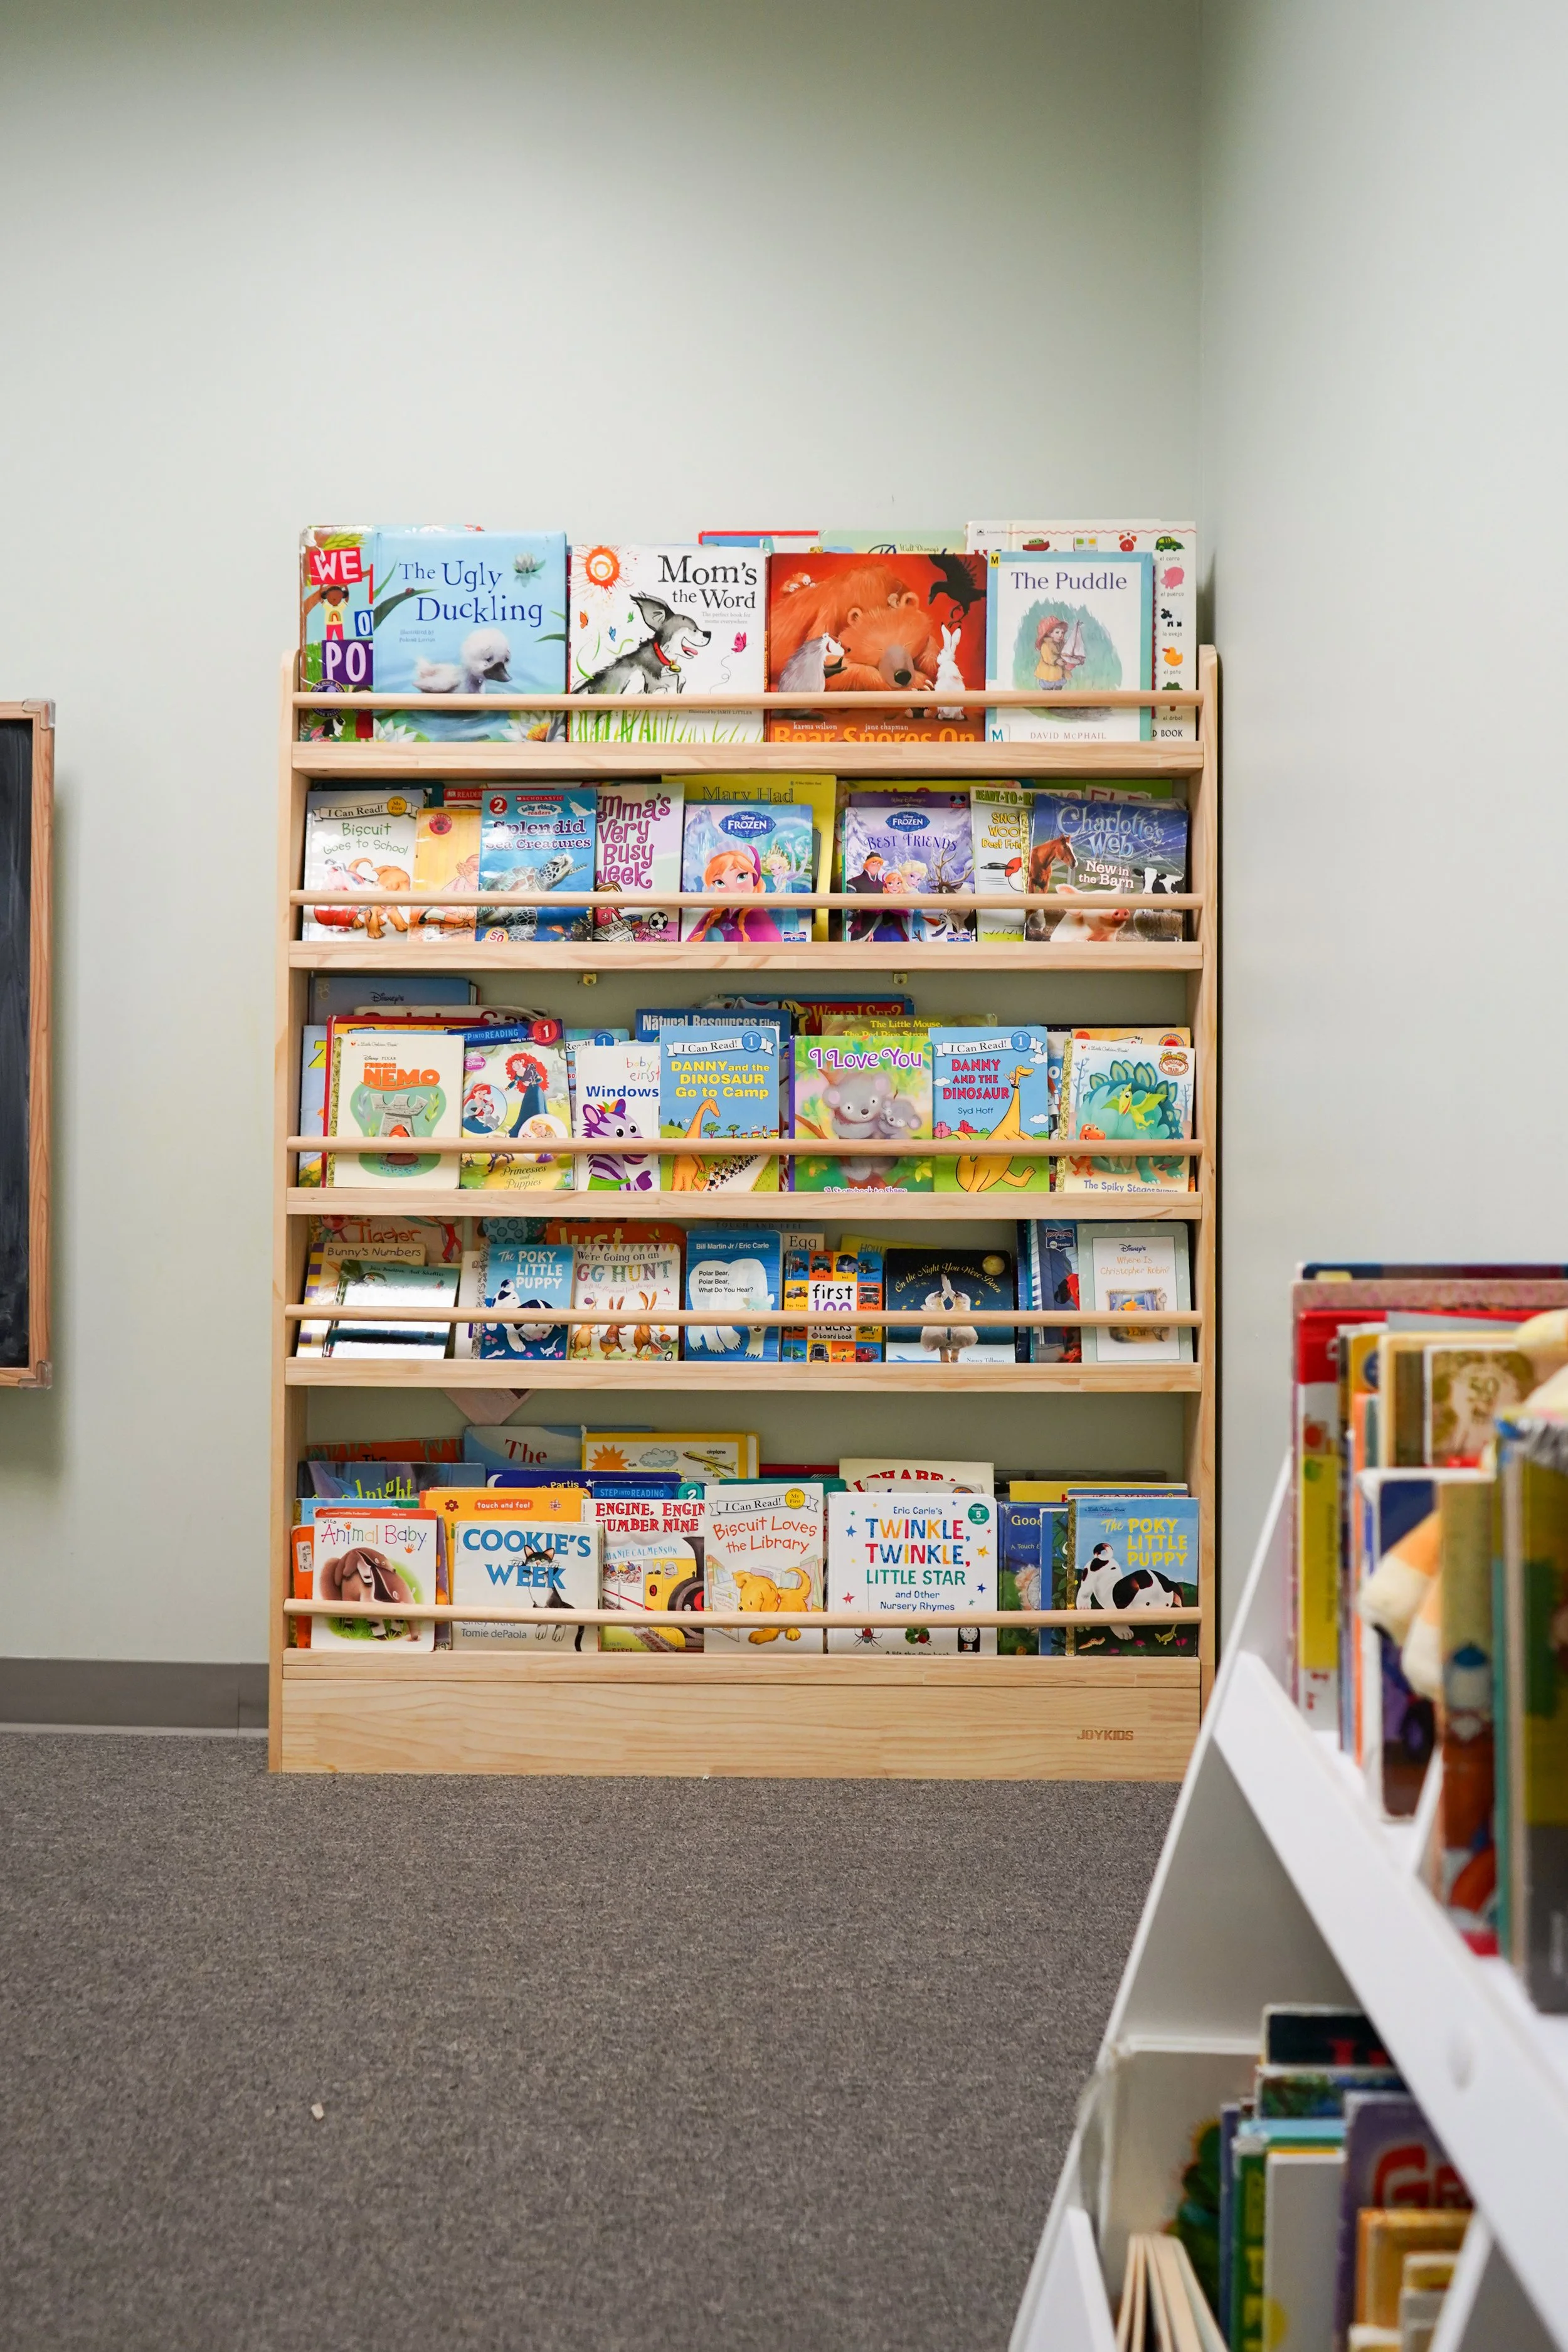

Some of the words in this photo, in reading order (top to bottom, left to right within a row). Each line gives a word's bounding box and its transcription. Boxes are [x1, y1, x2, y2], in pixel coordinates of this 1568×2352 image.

[314, 550, 359, 580] WE
[991, 556, 998, 564] M
[658, 555, 757, 585] Mom's
[399, 563, 435, 580] The
[442, 560, 502, 593] Ugly
[1011, 572, 1049, 590] The
[1056, 571, 1128, 590] Puddle
[672, 590, 697, 603] the
[699, 589, 756, 608] Word
[416, 595, 543, 627] Duckling
[865, 723, 878, 733] jane
[881, 724, 909, 732] chapman
[1161, 729, 1184, 738] BOOK
[758, 788, 793, 803] Had
[334, 809, 353, 817] Can
[357, 805, 384, 816] Read!
[494, 800, 503, 812] 2
[342, 823, 391, 837] Biscuit
[493, 819, 586, 837] Splendid
[728, 820, 766, 830] FROZEN
[1057, 806, 1165, 843] Charlotte's
[324, 841, 351, 855] Goes
[357, 839, 368, 848] to
[374, 840, 408, 856] School
[516, 839, 591, 849] Creatures
[982, 838, 1002, 849] Best
[1088, 832, 1134, 858] Web
[1086, 860, 1118, 875] New
[1119, 866, 1130, 877] in
[1079, 874, 1098, 884] the
[1099, 875, 1135, 889] Barn
[871, 1020, 886, 1028] The
[889, 1020, 911, 1028] Little
[913, 1020, 943, 1029] Mouse,
[485, 1029, 519, 1039] READING
[543, 1025, 549, 1038] 1
[681, 1044, 685, 1052] I
[688, 1044, 707, 1052] Can
[712, 1040, 737, 1050] Read!
[748, 1037, 754, 1046] 1
[951, 1044, 954, 1052] I
[957, 1044, 977, 1053] Can
[980, 1040, 1007, 1050] Read!
[1018, 1037, 1024, 1046] 1
[627, 1057, 653, 1072] baby
[810, 1049, 822, 1069] I
[827, 1048, 879, 1069] Love
[882, 1048, 923, 1068] You
[671, 1061, 728, 1072] DANNY
[728, 1064, 748, 1072] and
[751, 1064, 770, 1072] the
[952, 1059, 1001, 1071] DANNY
[363, 1069, 440, 1086] NEMO
[680, 1074, 765, 1084] DINOSAUR
[953, 1075, 977, 1084] AND
[978, 1075, 998, 1083] THE
[586, 1086, 659, 1097] Windows
[675, 1087, 697, 1098] Go
[702, 1088, 718, 1097] to
[723, 1087, 769, 1099] Camp
[943, 1087, 1010, 1099] DINOSAUR
[502, 1165, 547, 1177] Princesses
[506, 1179, 542, 1190] Puppies
[1084, 1180, 1098, 1189] The
[1101, 1182, 1124, 1192] Spiky
[327, 1248, 369, 1257] Bunny's
[372, 1247, 421, 1256] Numbers
[1120, 1244, 1146, 1253] Disney's
[498, 1251, 514, 1261] The
[519, 1251, 557, 1263] POKY
[578, 1251, 601, 1261] We're
[604, 1252, 630, 1263] Going
[516, 1264, 563, 1276] LITTLE
[612, 1259, 672, 1282] HUNT
[1100, 1267, 1145, 1276] Christopher
[516, 1278, 563, 1289] PUPPY
[895, 1281, 906, 1293] On
[906, 1271, 916, 1283] the
[917, 1264, 940, 1277] Night
[942, 1263, 960, 1273] You
[961, 1266, 982, 1279] Were
[982, 1274, 1002, 1293] Born
[812, 1284, 853, 1300] first
[505, 1439, 548, 1465] The
[600, 1489, 618, 1497] STEP
[631, 1489, 664, 1497] READING
[687, 1489, 696, 1500] 2
[596, 1502, 654, 1516] ENGINE,
[732, 1503, 751, 1511] Can
[755, 1498, 781, 1508] Read!
[663, 1518, 698, 1532] NINE
[713, 1517, 767, 1540] Biscuit
[771, 1516, 817, 1537] Loves
[866, 1518, 970, 1542] TWINKLE,
[1101, 1518, 1123, 1533] The
[1128, 1518, 1179, 1534] POKY
[321, 1524, 378, 1545] Animal
[385, 1525, 427, 1551] Baby
[463, 1528, 591, 1557] COOKIE'S
[1128, 1535, 1187, 1550] LITTLE
[632, 1545, 677, 1556] CALMENSON
[726, 1542, 746, 1554] the
[751, 1535, 810, 1554] Library
[866, 1544, 970, 1567] TWINKLE,
[1128, 1552, 1189, 1567] PUPPY
[484, 1564, 566, 1589] WEEK
[866, 1569, 916, 1584] LITTLE
[923, 1570, 966, 1585] STAR
[650, 1587, 656, 1595] 9
[880, 1601, 917, 1611] Nursery
[919, 1601, 955, 1612] Rhymes
[461, 1629, 489, 1638] Tomie
[491, 1629, 527, 1639] dePaola
[1077, 1730, 1133, 1740] JOYKIDS
